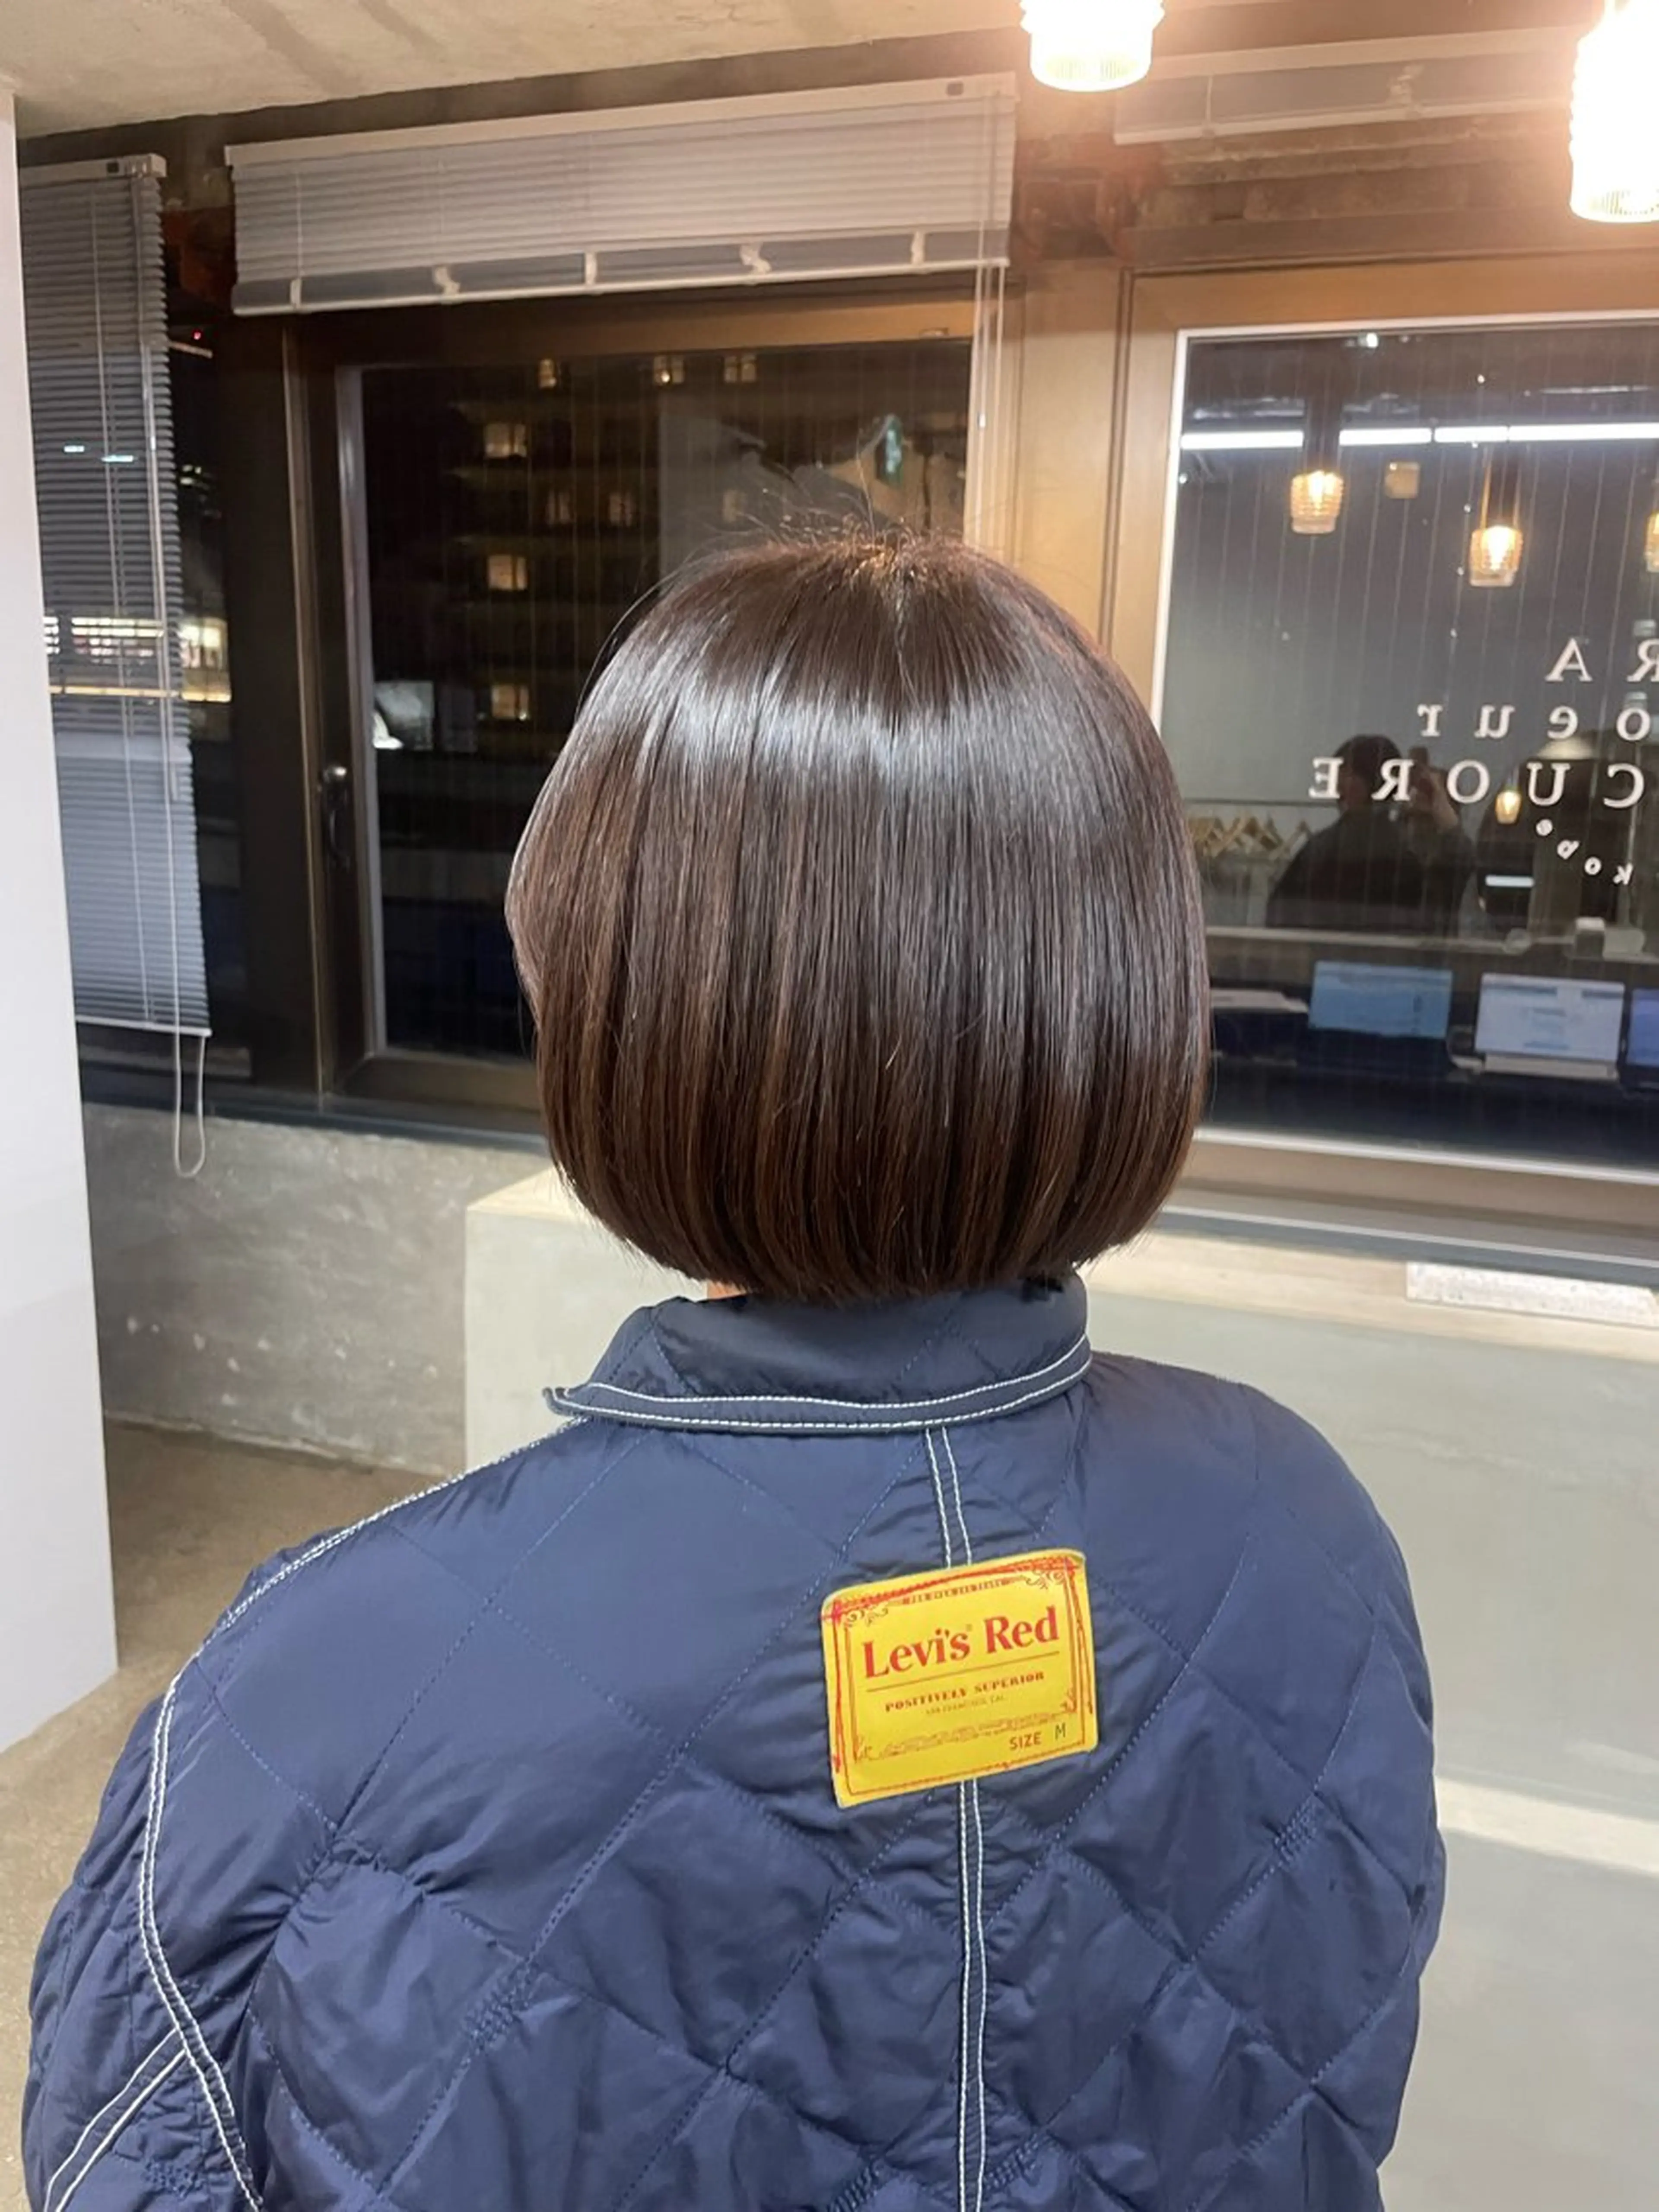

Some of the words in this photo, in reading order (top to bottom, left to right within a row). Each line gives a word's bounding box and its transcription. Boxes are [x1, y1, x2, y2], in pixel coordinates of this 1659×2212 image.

[864, 1628, 971, 1679] Levi's
[984, 1605, 1060, 1654] Red
[974, 1671, 1044, 1693] SUPERIOR
[1009, 1732, 1042, 1751] SIZE
[1055, 1723, 1066, 1740] M
